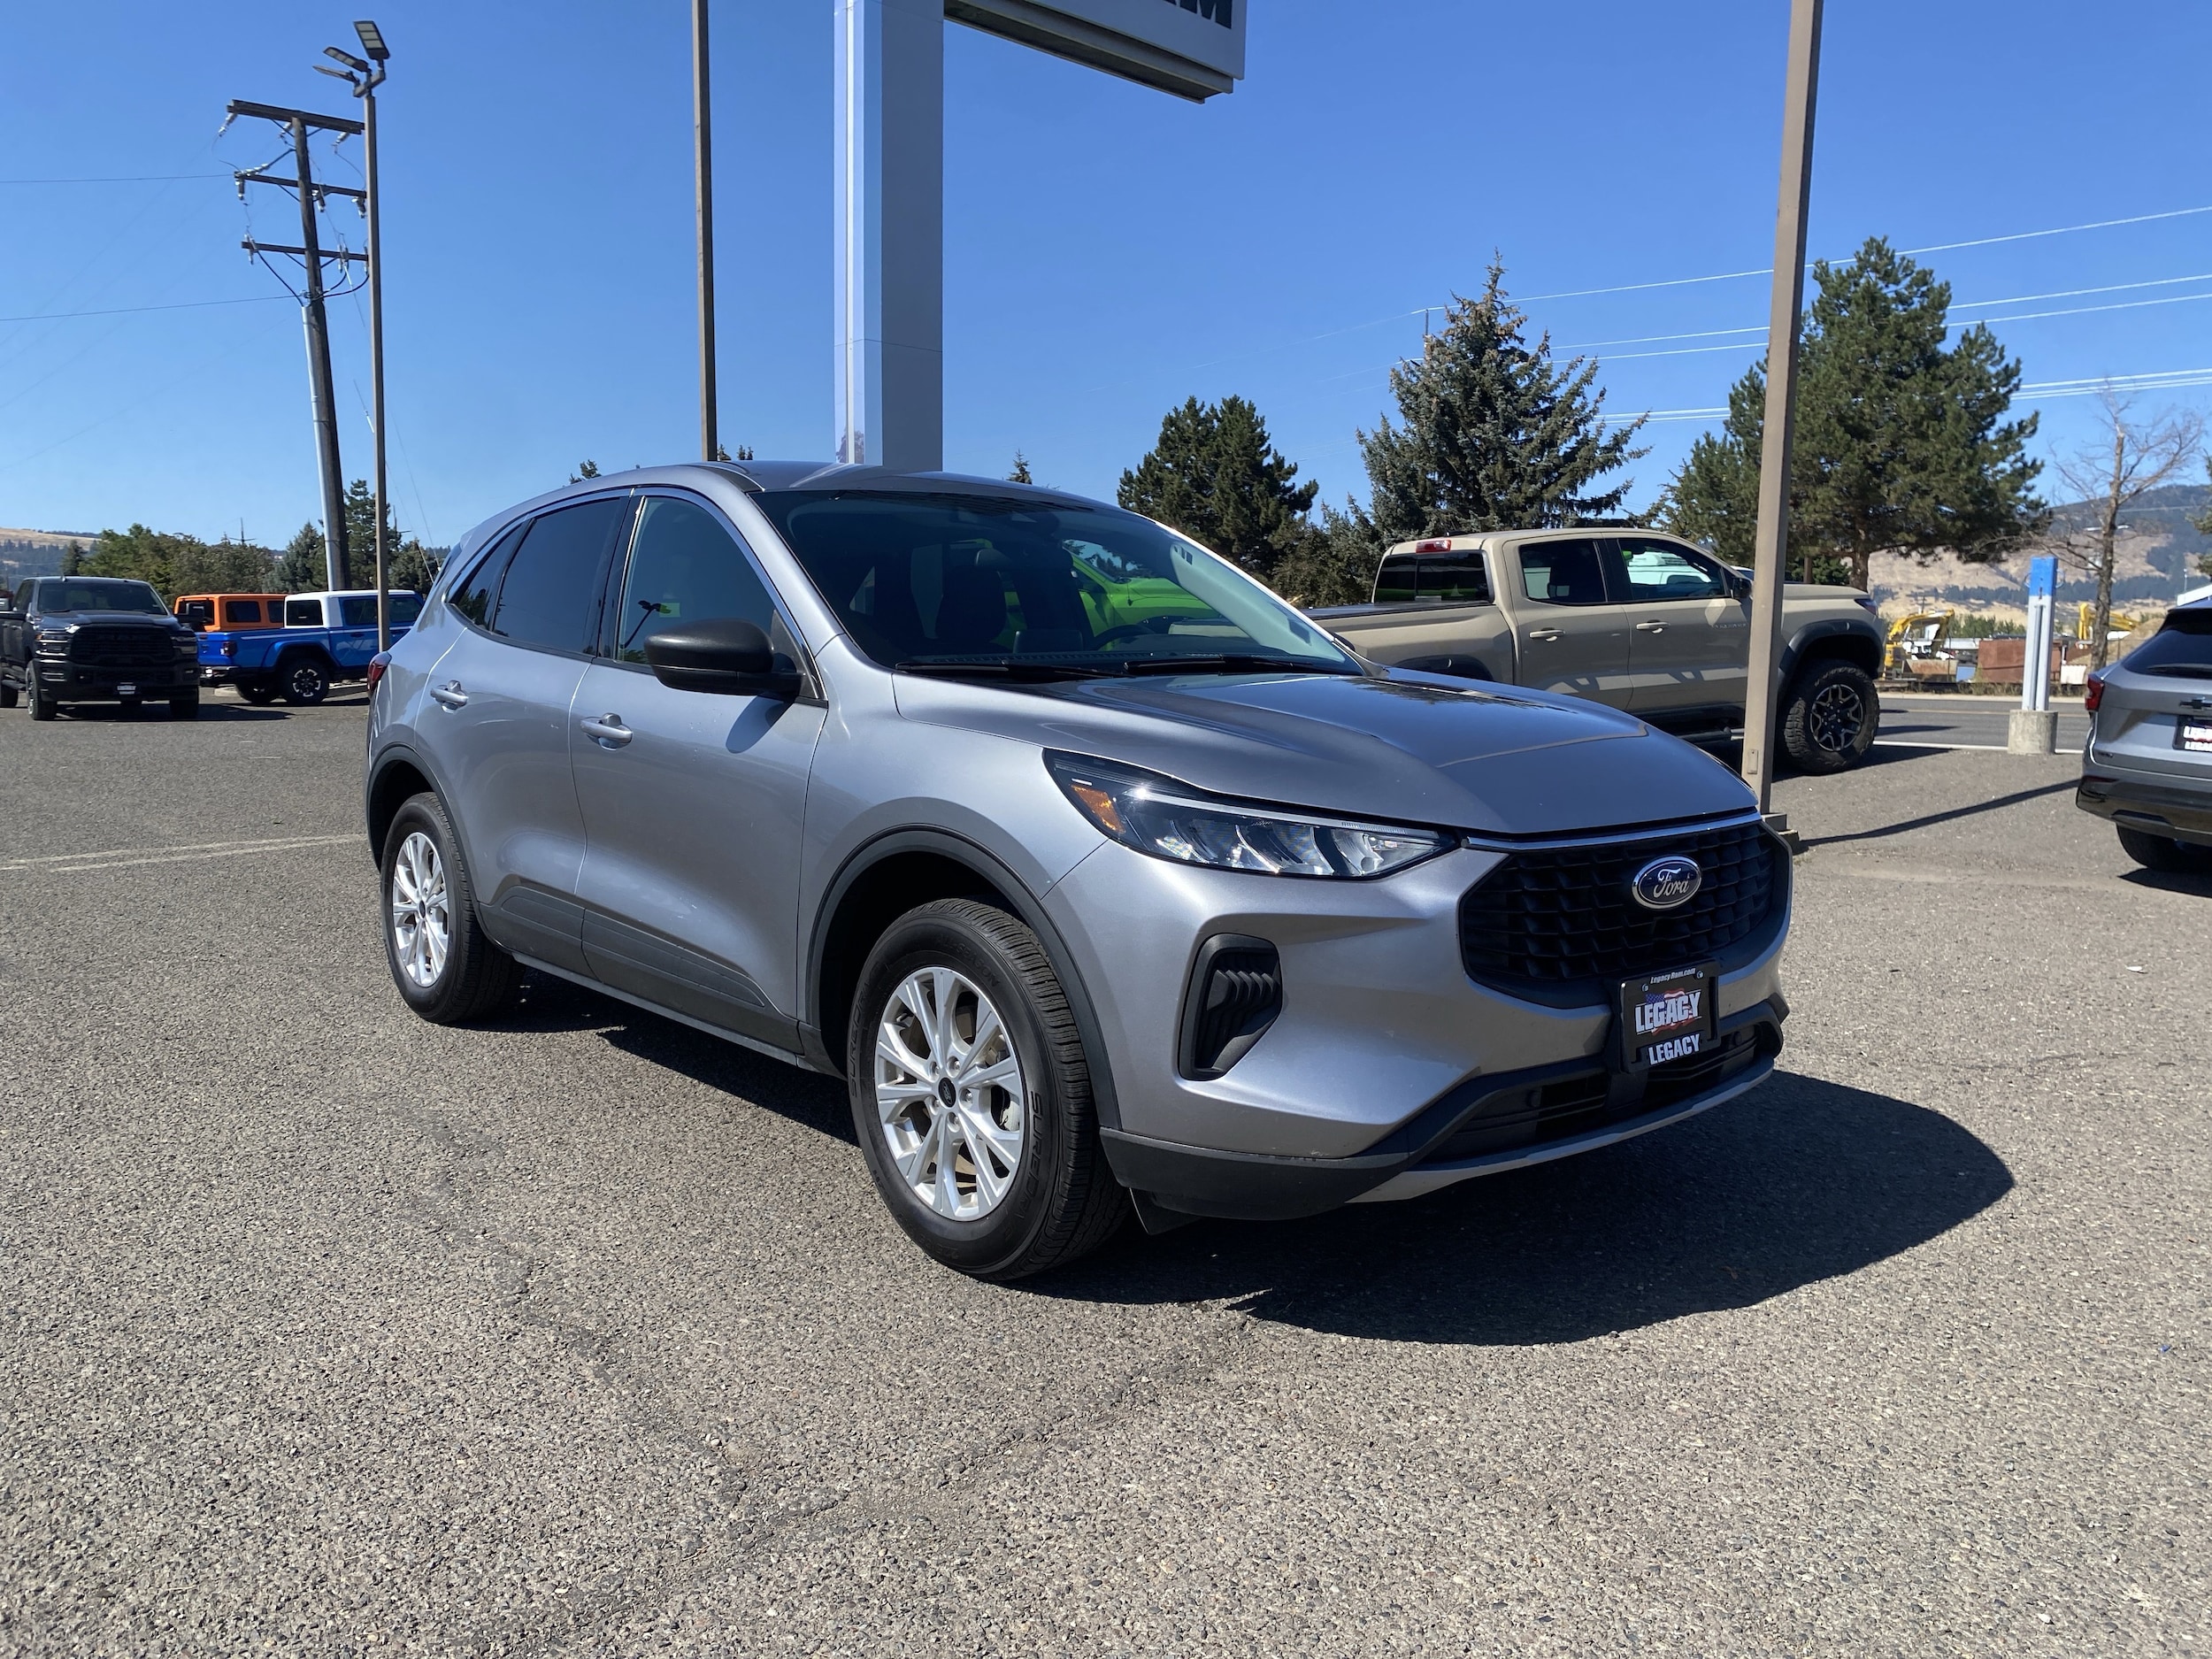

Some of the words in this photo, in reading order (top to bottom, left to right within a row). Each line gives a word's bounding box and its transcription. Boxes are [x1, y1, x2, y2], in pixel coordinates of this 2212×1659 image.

[1653, 868, 1691, 898] Ford
[1635, 991, 1701, 1033] LEGACY
[1648, 1033, 1700, 1065] LEGACY
[1004, 1091, 1043, 1240] SUREDRIE
